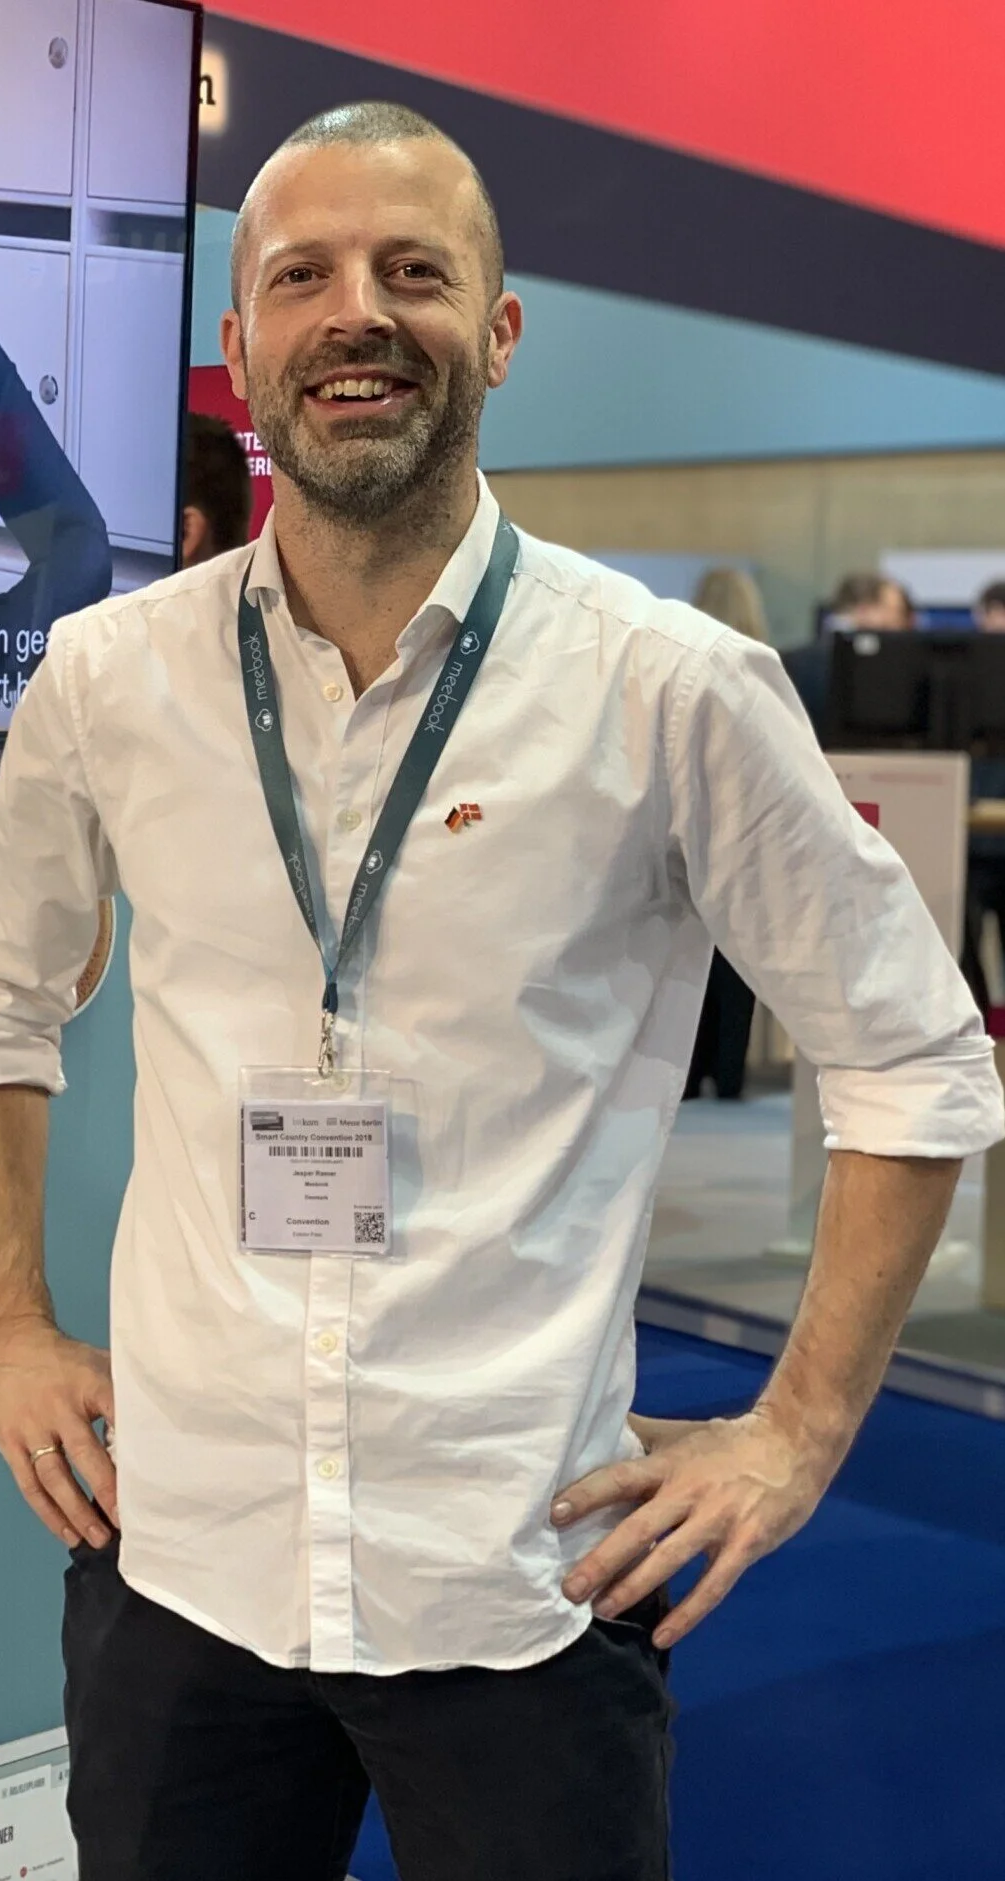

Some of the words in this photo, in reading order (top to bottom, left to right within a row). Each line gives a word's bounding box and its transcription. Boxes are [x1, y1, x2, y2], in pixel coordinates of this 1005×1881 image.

[16, 629, 50, 662] ge
[243, 631, 268, 701] meebook
[424, 661, 463, 733] meebook
[255, 1133, 278, 1141] Smart
[279, 1133, 308, 1143] Country
[310, 1134, 353, 1142] Convention
[248, 1211, 256, 1220] C
[286, 1217, 330, 1226] Convention
